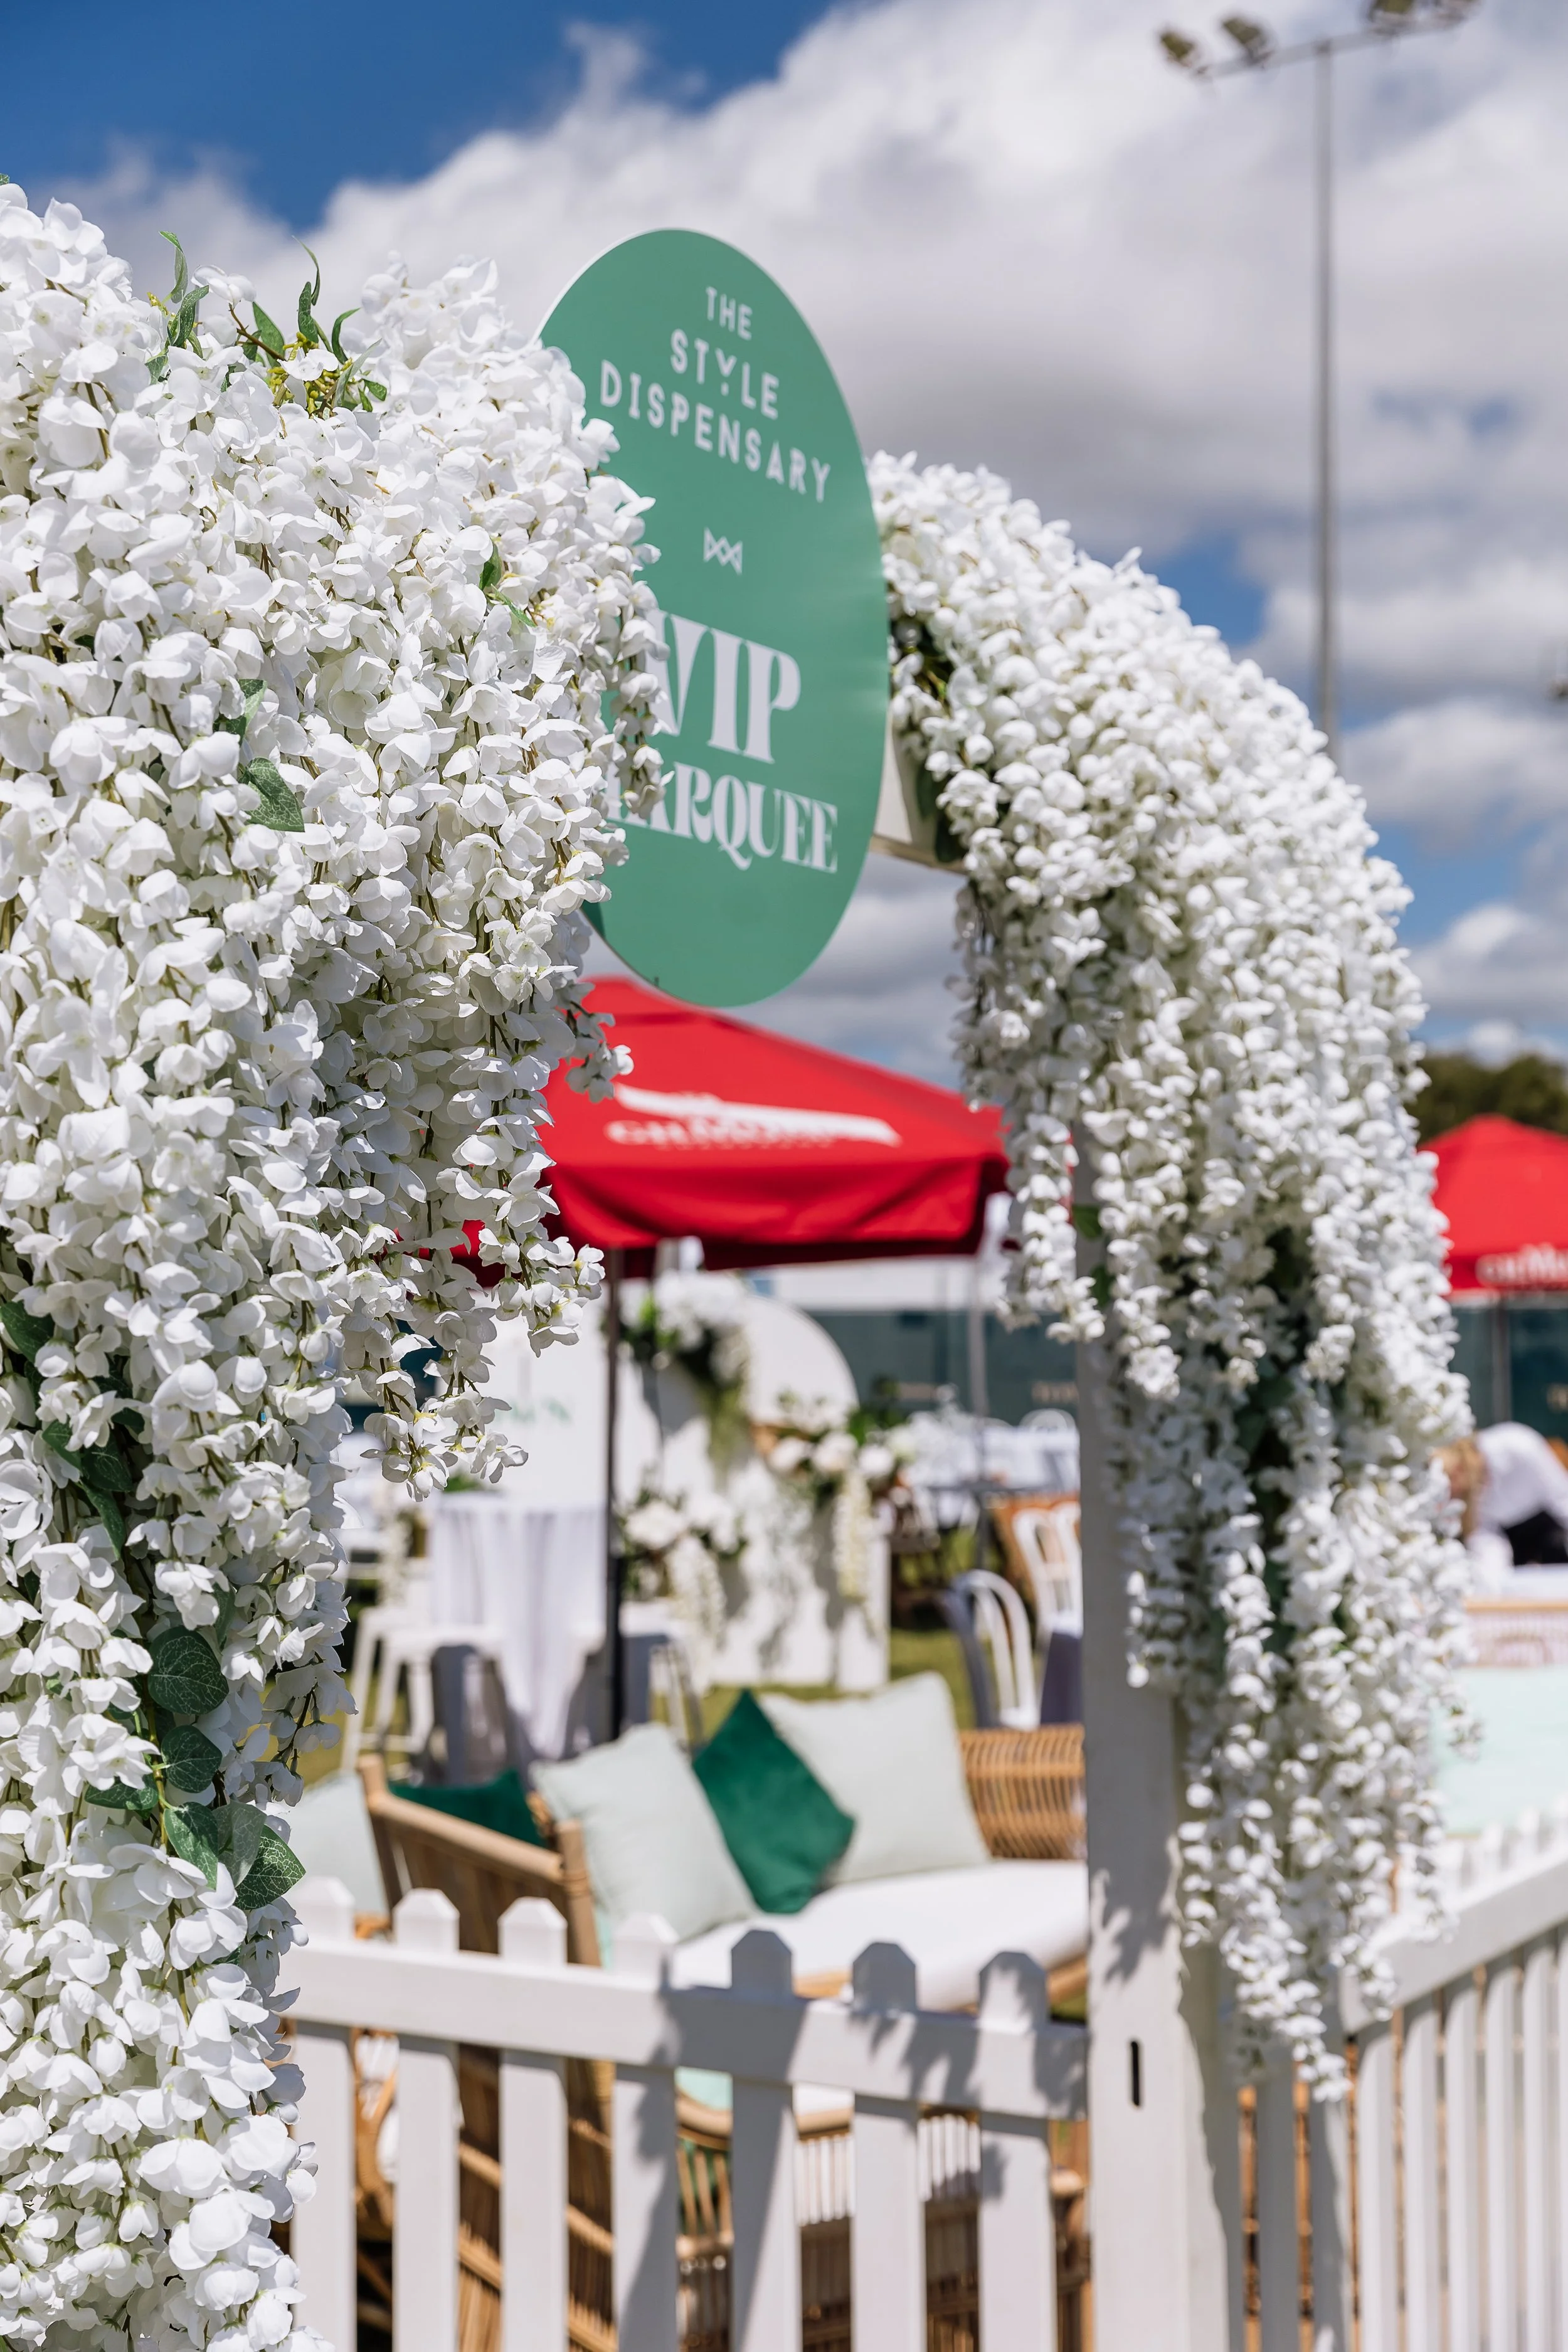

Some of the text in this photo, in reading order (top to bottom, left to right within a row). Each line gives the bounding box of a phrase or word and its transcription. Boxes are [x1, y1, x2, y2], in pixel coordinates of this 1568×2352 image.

[706, 286, 753, 340] THE
[600, 359, 830, 502] DISPENSARY
[670, 329, 779, 420] STYLE
[645, 608, 802, 764] VIP
[605, 760, 838, 874] RQUEE
